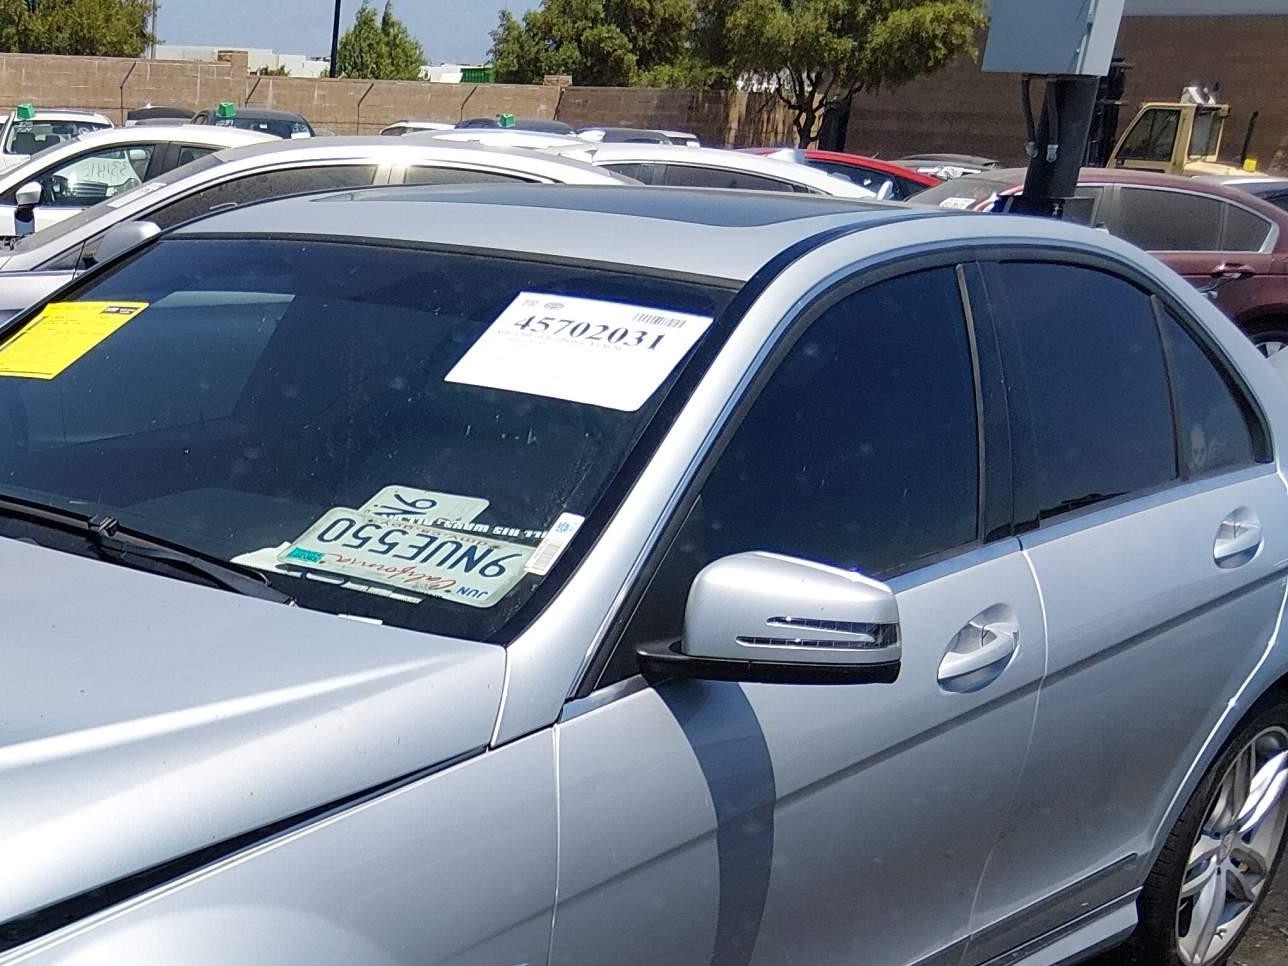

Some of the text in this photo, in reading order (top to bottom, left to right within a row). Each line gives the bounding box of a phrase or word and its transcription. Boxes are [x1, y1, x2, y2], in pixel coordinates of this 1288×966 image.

[513, 315, 665, 350] 45702031
[316, 517, 523, 578] 9NUE550
[327, 552, 457, 591] California
[456, 585, 489, 599] JUN
